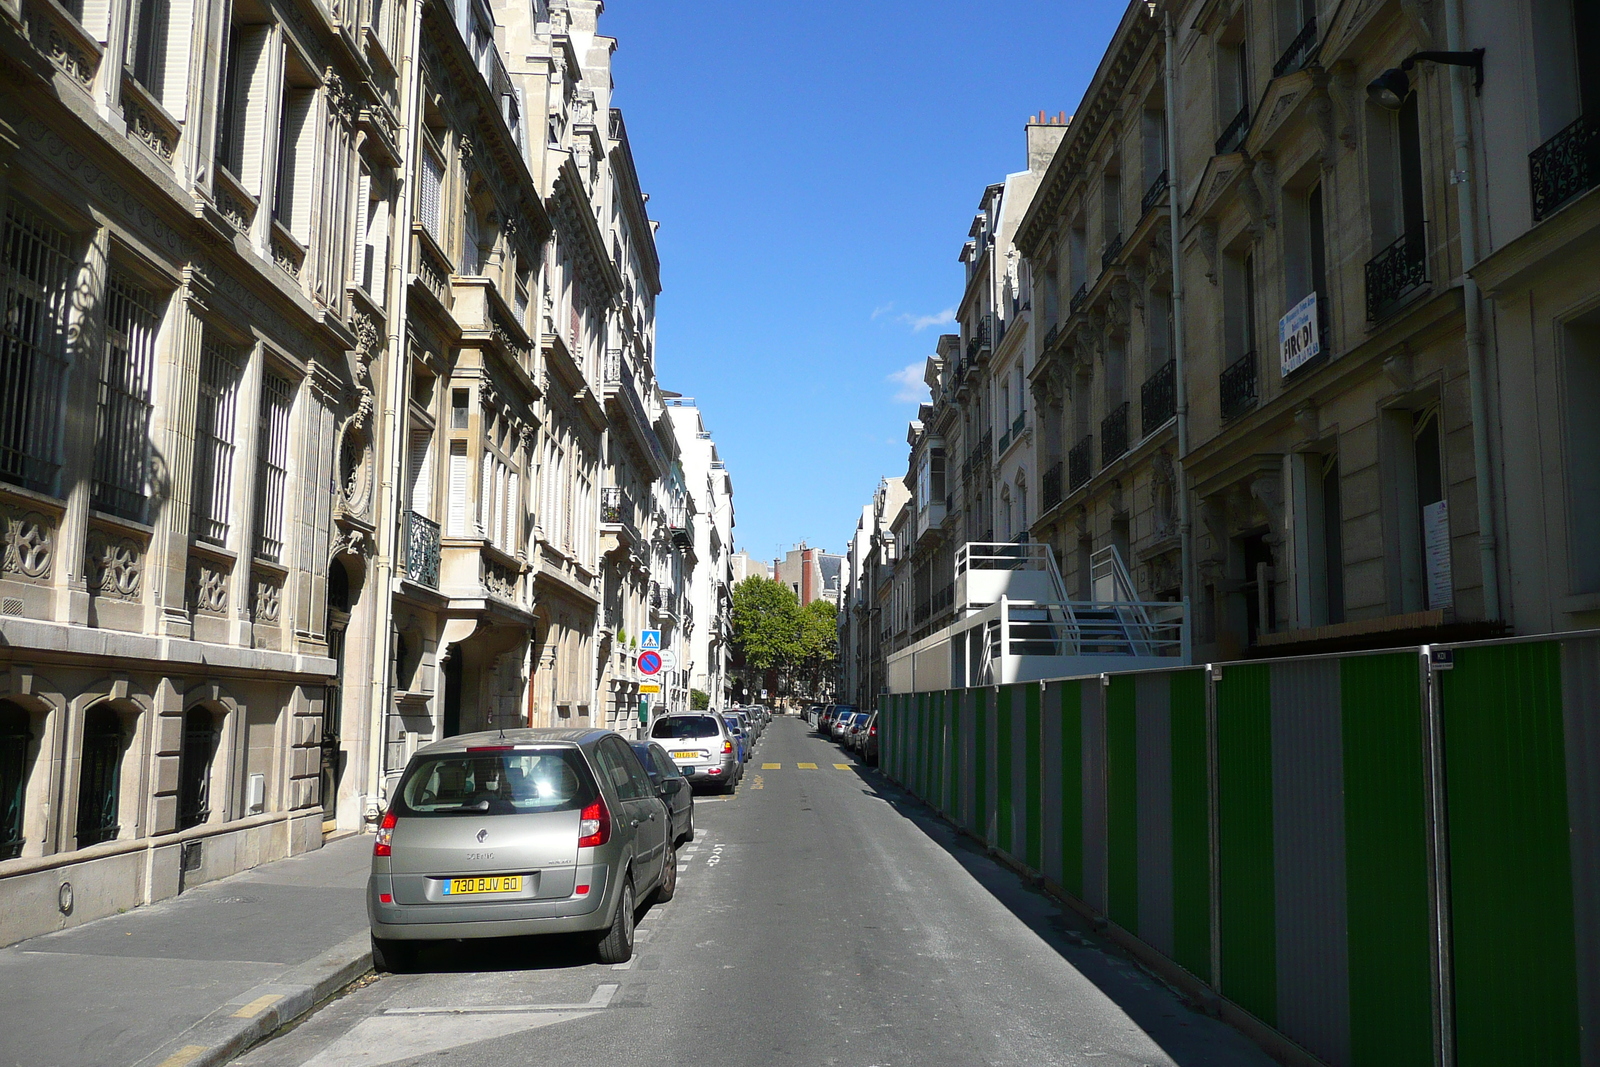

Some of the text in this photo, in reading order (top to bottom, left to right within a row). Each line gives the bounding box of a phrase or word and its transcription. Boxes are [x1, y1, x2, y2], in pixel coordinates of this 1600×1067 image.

[454, 877, 517, 892] 730 BJV 60
